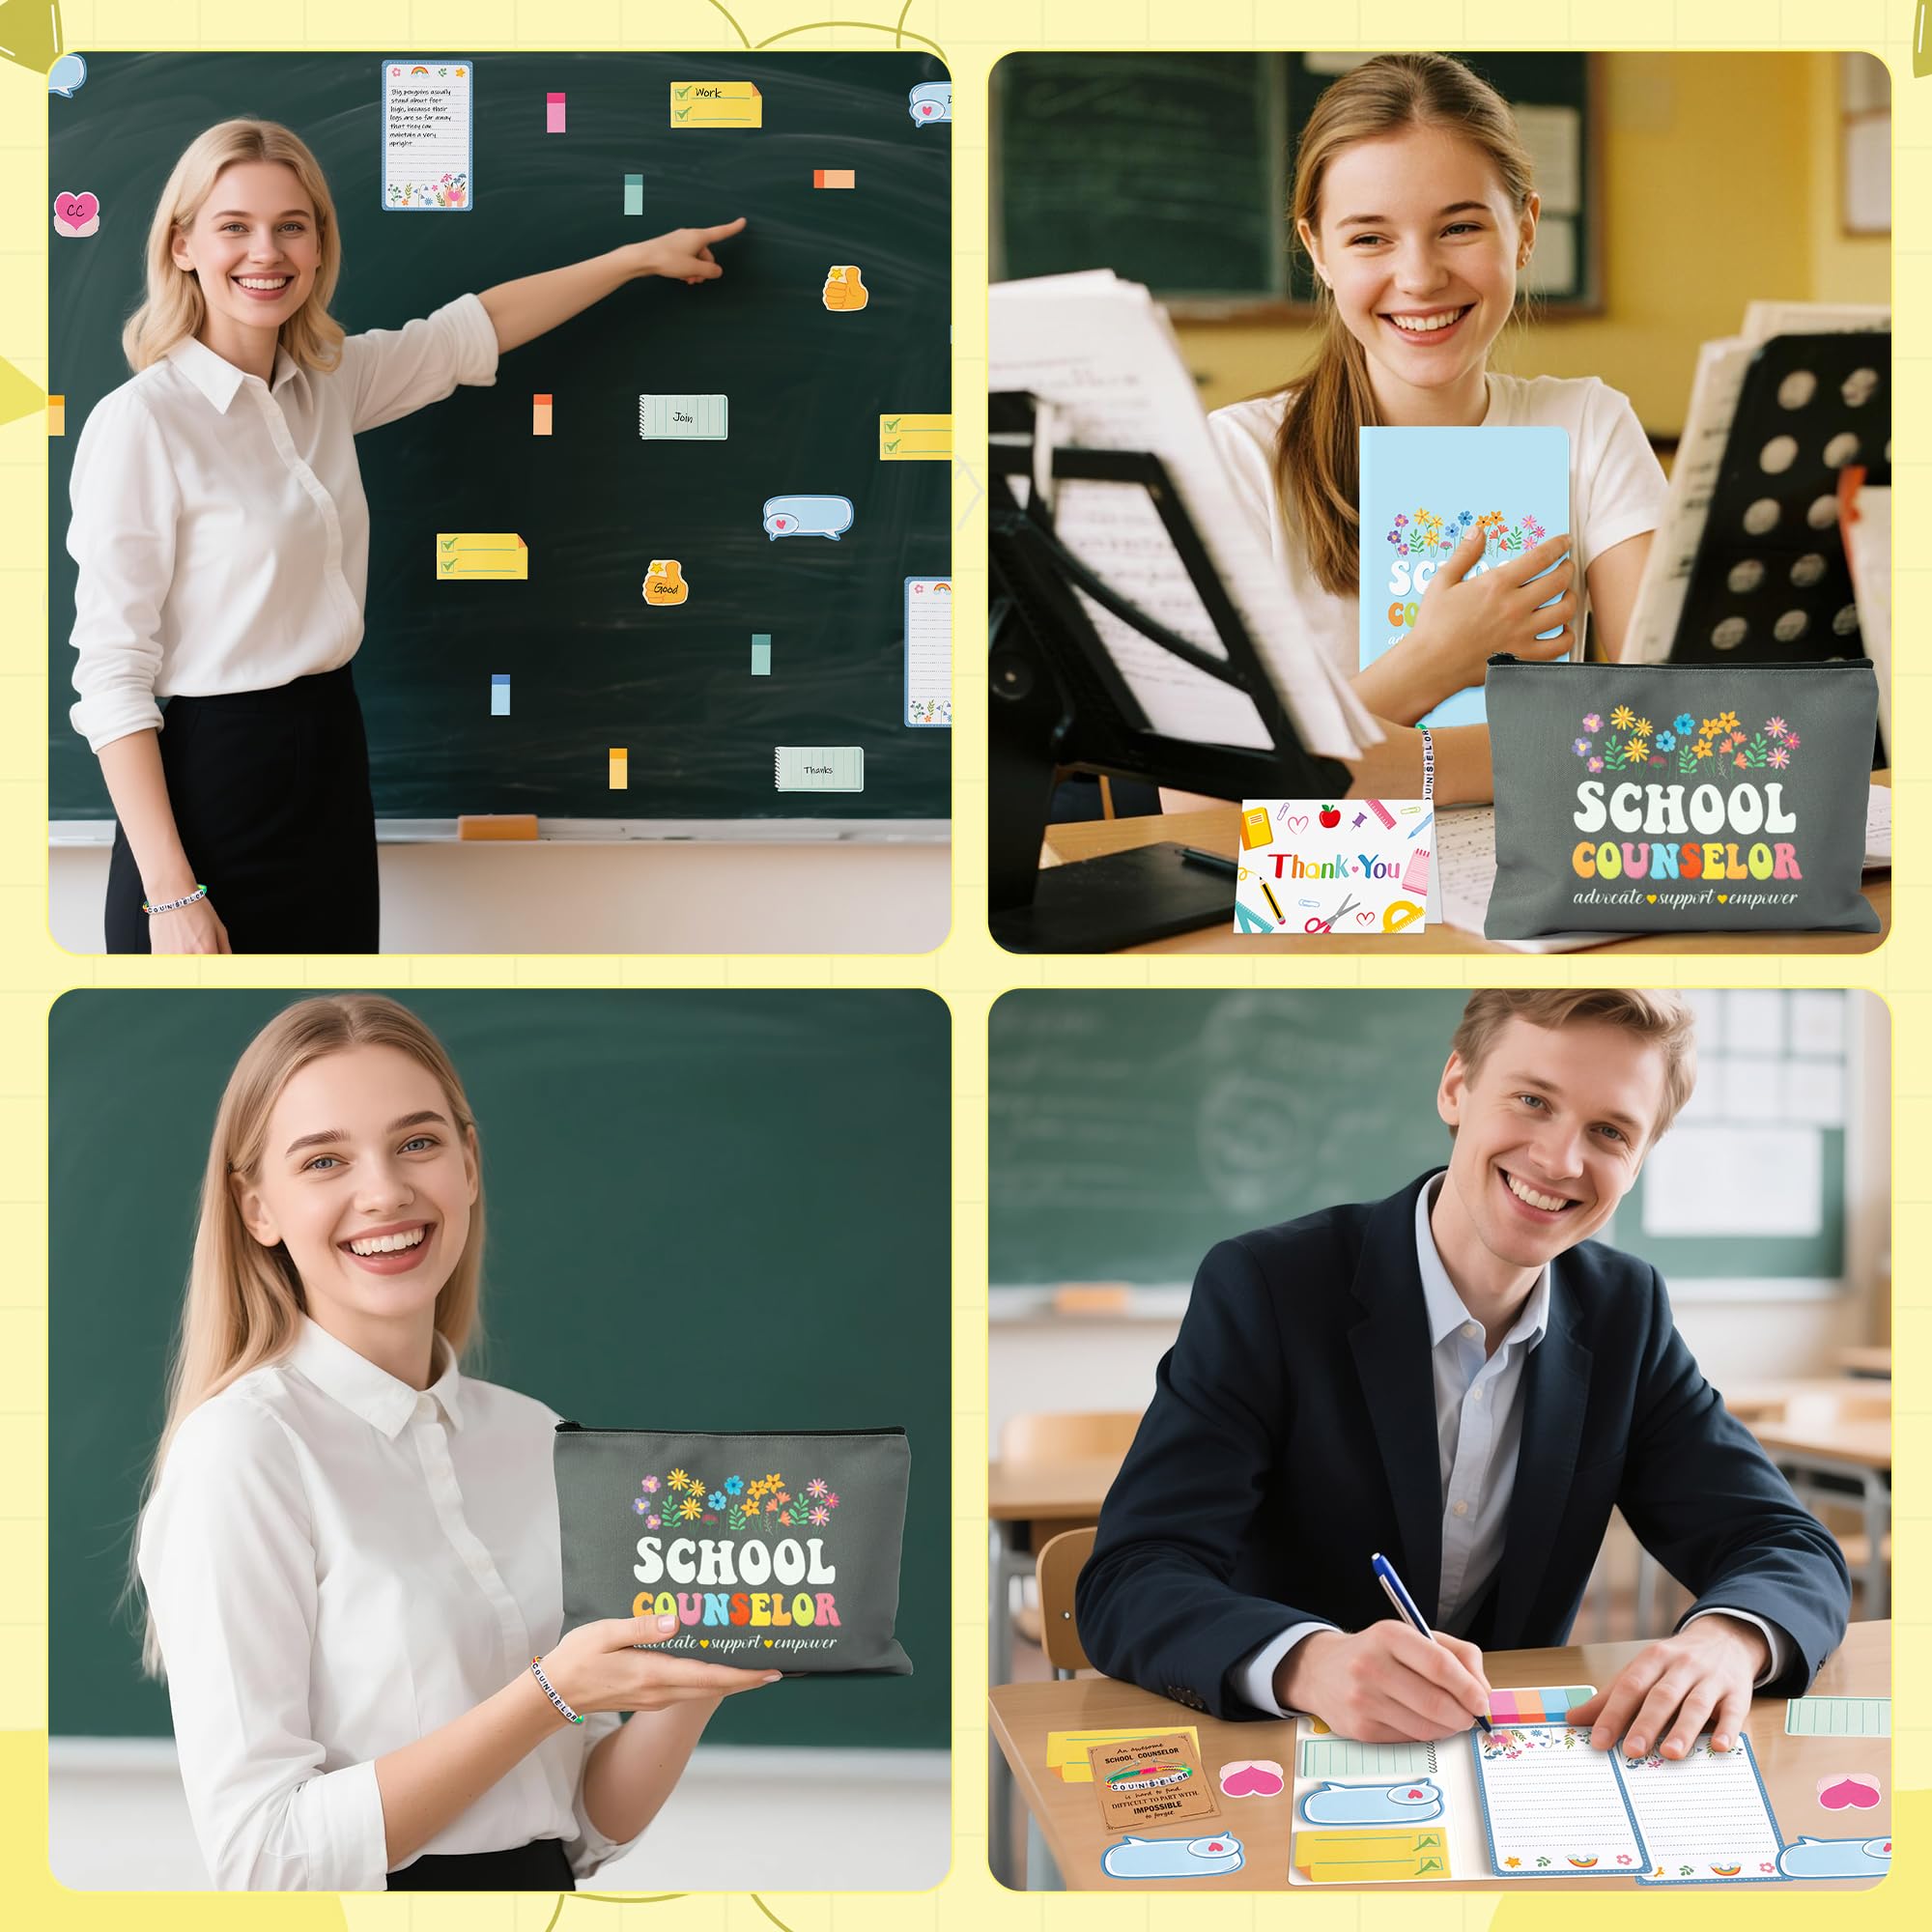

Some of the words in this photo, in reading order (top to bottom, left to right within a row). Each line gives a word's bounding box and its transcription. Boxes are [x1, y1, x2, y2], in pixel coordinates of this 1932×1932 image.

[696, 88, 722, 98] Work
[67, 204, 85, 217] CC
[673, 412, 694, 423] Join
[654, 582, 679, 594] Good
[1573, 781, 1797, 835] SCHOOL
[1267, 854, 1350, 879] Thank
[1357, 854, 1400, 879] You
[1572, 840, 1803, 880] COUNSELOR
[1573, 888, 1645, 905] advocate
[1658, 888, 1716, 910] support
[1728, 893, 1798, 910] empower
[633, 1536, 836, 1586] SCHOOL
[632, 1591, 841, 1627] COUNSELOR
[709, 1634, 761, 1654] support
[774, 1638, 838, 1654] empower
[532, 1662, 578, 1720] COUNSELOR
[1105, 1755, 1133, 1764] SCHOOL
[1138, 1747, 1179, 1758] COUNSELOR
[1131, 1743, 1163, 1751] awesome
[1112, 1773, 1188, 1790] COUNSELOR
[1136, 1789, 1153, 1798] hard
[1112, 1800, 1148, 1808] DIFFICULT
[1133, 1801, 1182, 1814] IMPOSSIBLE
